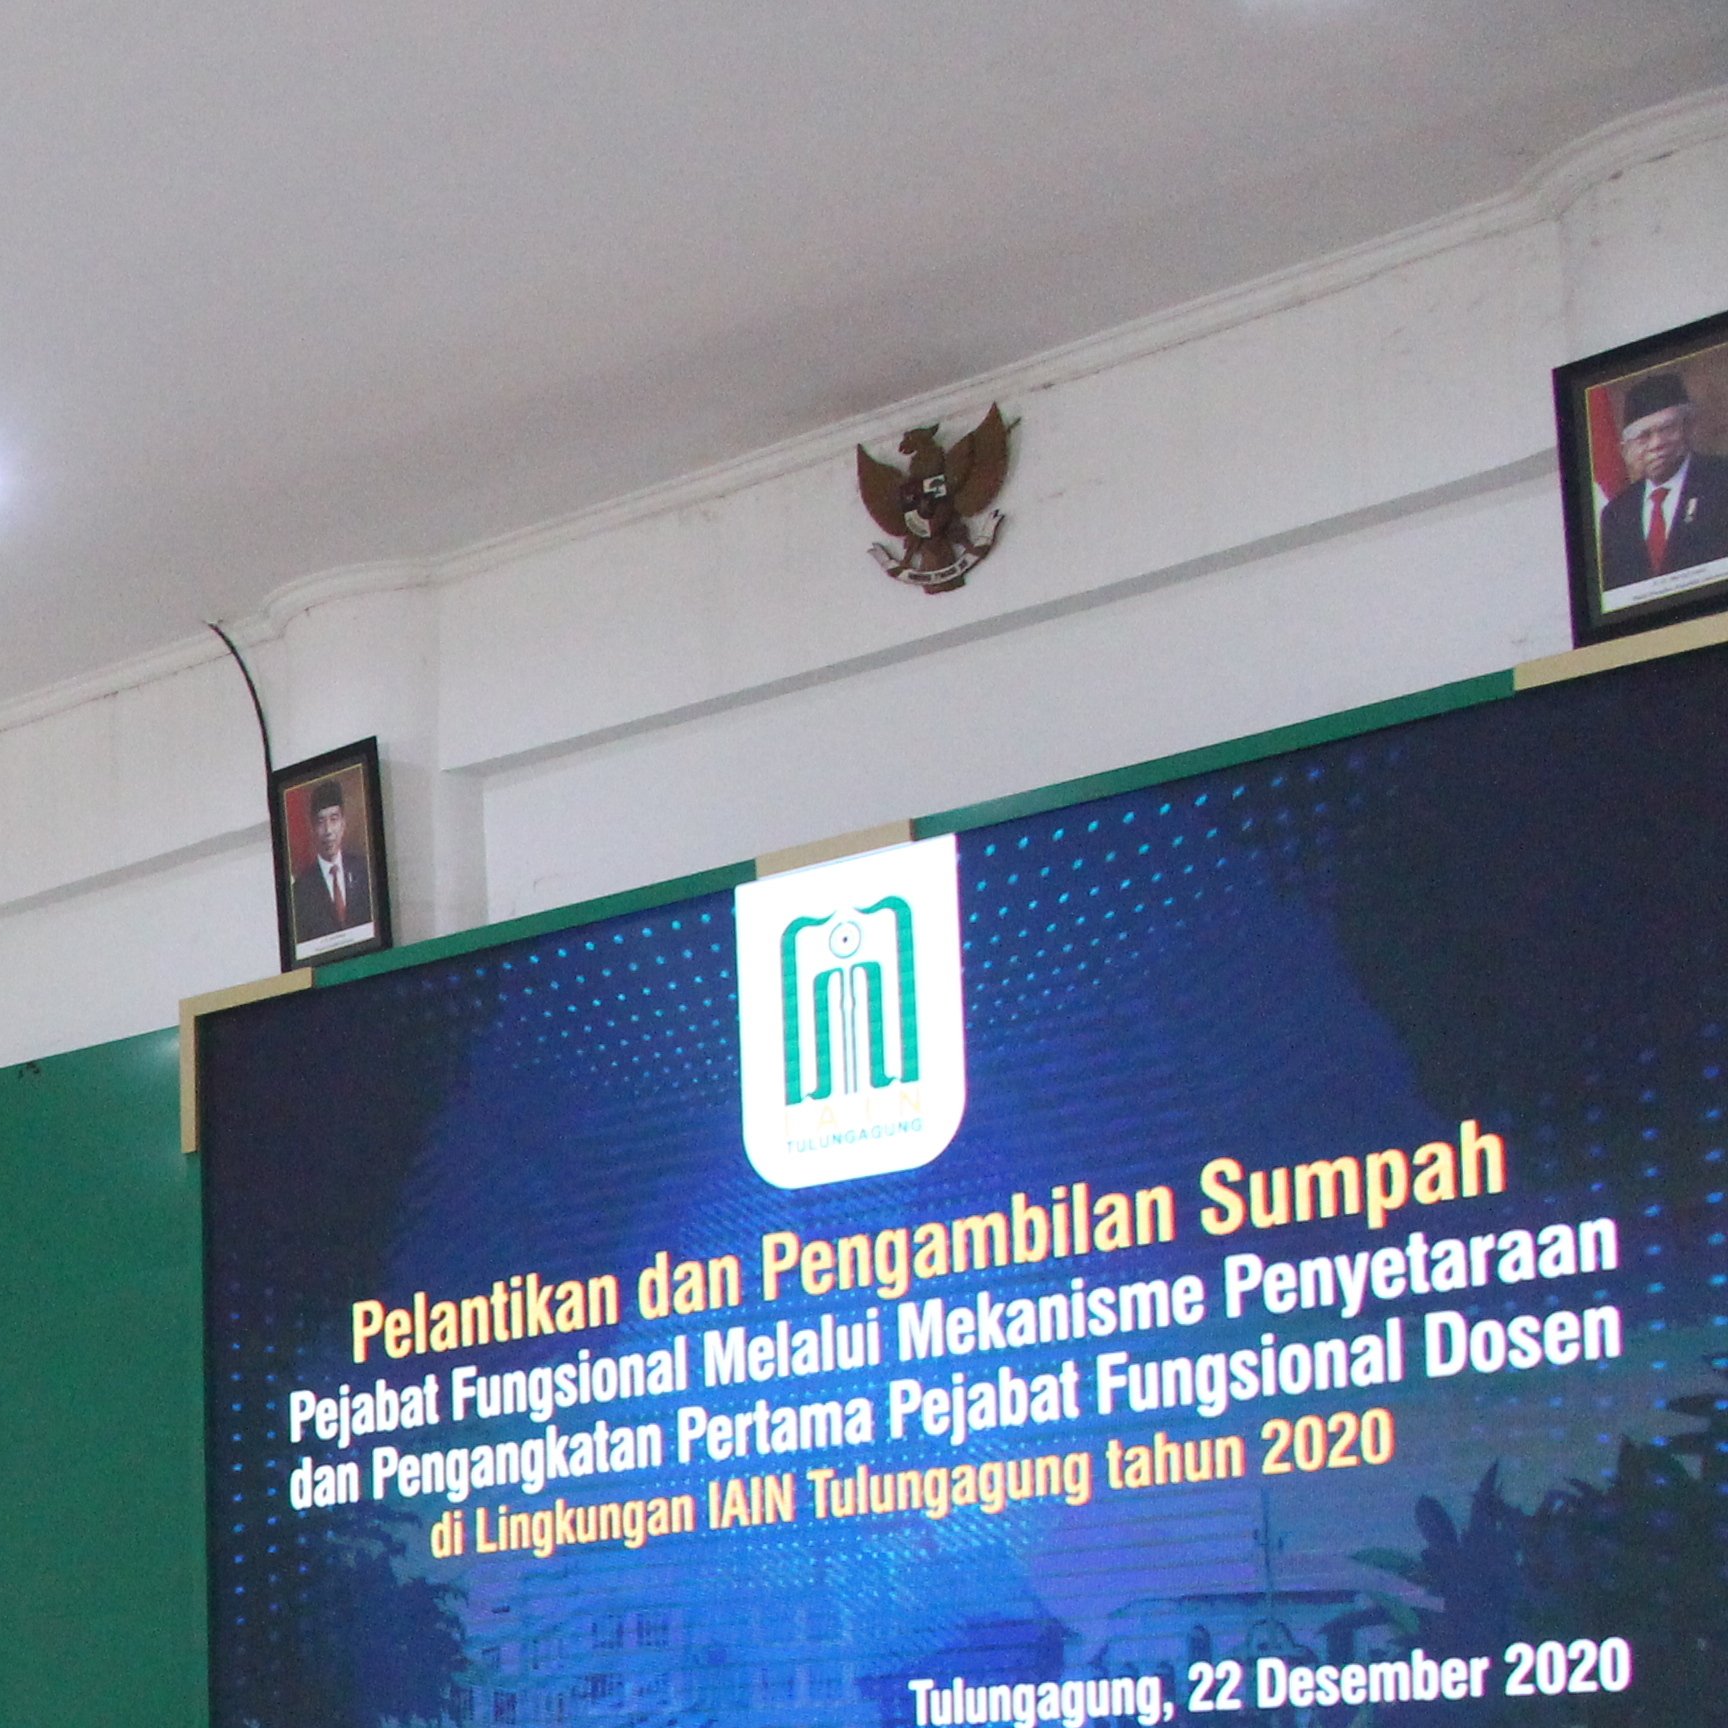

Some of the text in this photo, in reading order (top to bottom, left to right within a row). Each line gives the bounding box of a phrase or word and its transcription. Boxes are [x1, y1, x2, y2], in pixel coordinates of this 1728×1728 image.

[786, 1117, 924, 1153] TULUNGAGUNG
[352, 1118, 1507, 1364] Pelantikan dan Pengambilan Sumpah
[289, 1218, 1619, 1449] Pejabat Fungsional Melalui Mekanisme Penyetaraan
[289, 1305, 1622, 1510] dan Pengangkatan Pertama Pejabat Fungsional Dosen
[430, 1407, 1396, 1559] di Lingkungan IAIN Tulungagung tahun 2020
[1188, 1660, 1243, 1713] 22
[1256, 1649, 1491, 1709] Desember
[1504, 1636, 1632, 1697] 2020
